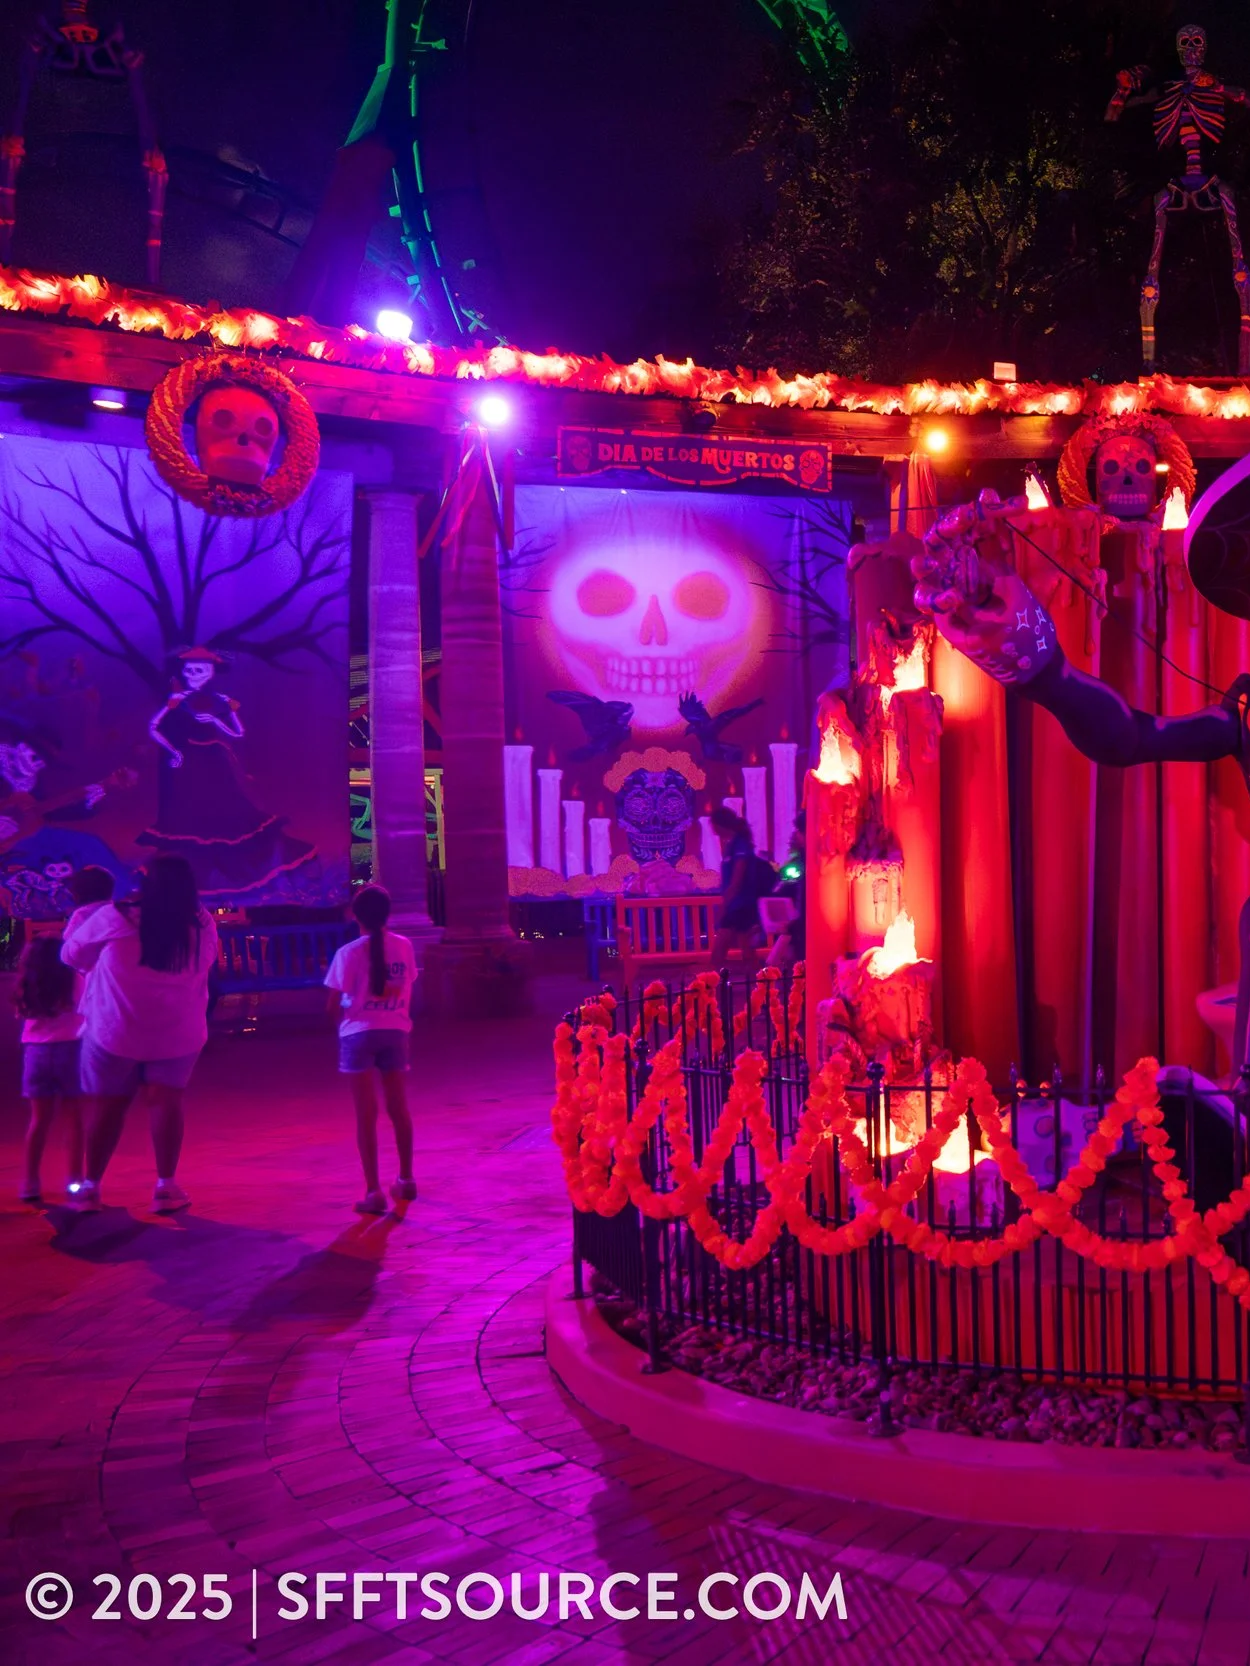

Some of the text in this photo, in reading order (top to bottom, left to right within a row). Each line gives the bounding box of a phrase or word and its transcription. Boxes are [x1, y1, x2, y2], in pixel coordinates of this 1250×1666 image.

[598, 443, 795, 474] DIA DE LOS MUERTOS
